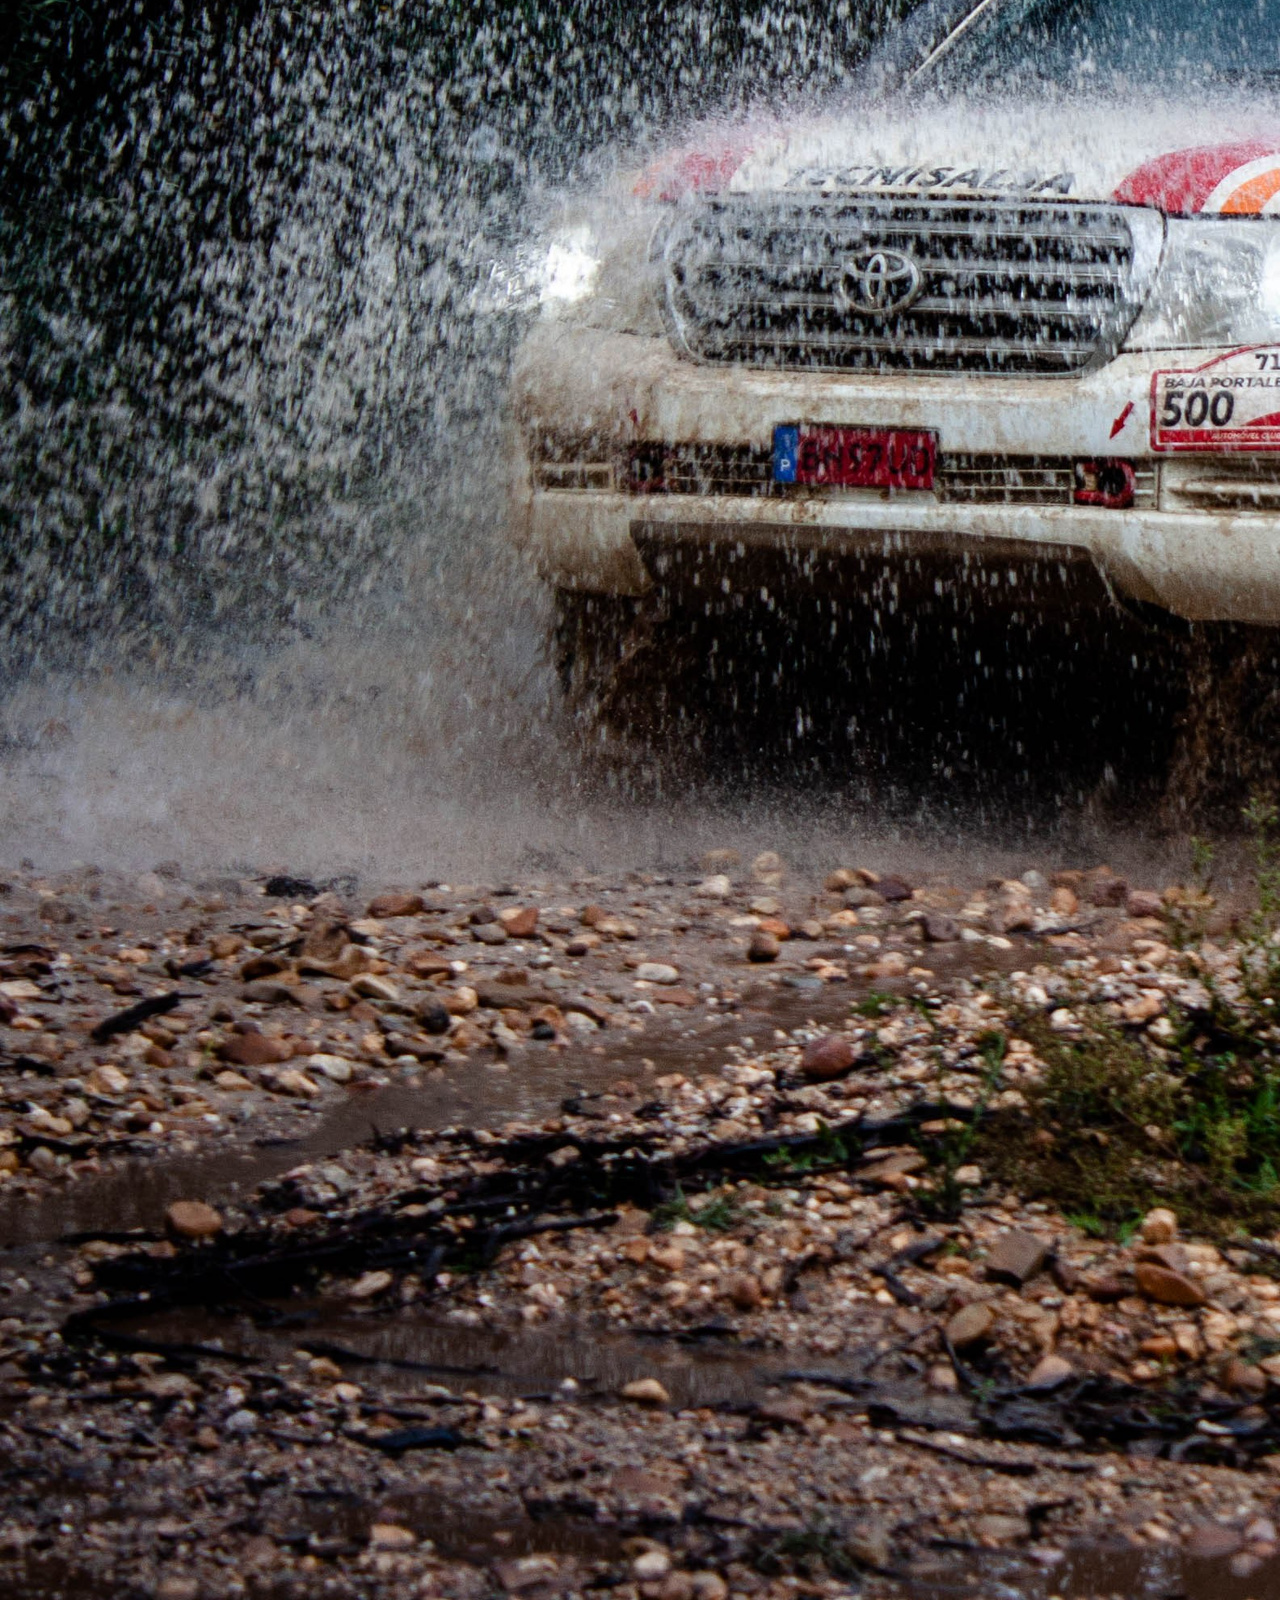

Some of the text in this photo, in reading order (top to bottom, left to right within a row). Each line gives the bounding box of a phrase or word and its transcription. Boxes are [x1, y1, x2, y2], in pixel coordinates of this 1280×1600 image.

[1164, 376, 1205, 388] BAJA
[1160, 389, 1235, 428] 500
[780, 458, 791, 472] P
